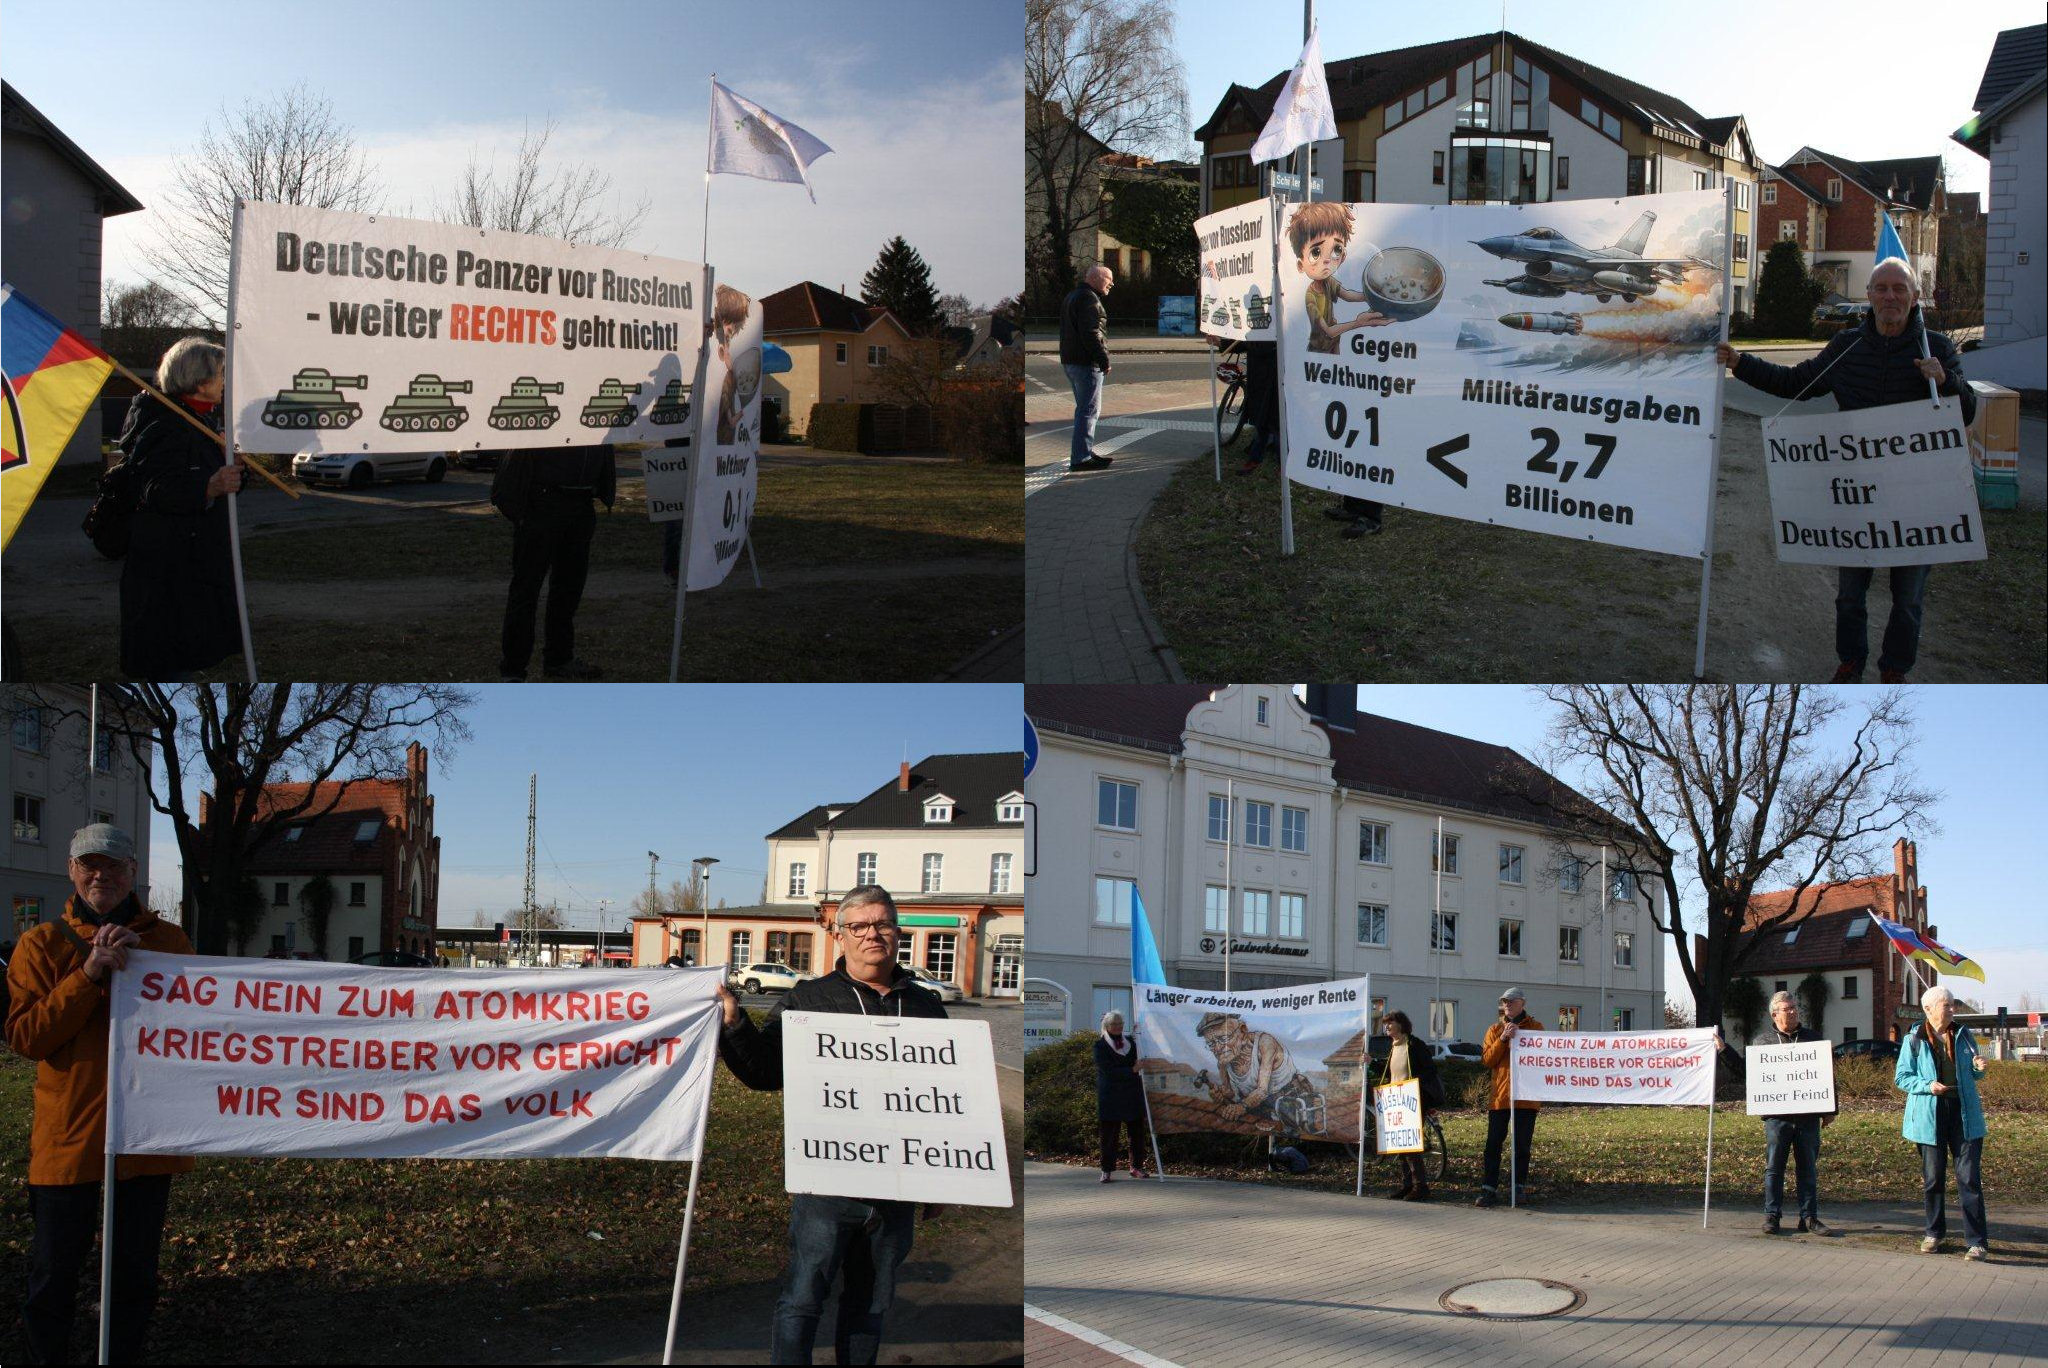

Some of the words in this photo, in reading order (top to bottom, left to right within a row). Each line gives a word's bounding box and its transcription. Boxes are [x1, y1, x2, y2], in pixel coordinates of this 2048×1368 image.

[1220, 215, 1263, 247] Russland
[276, 231, 448, 285] Deutsche
[455, 249, 553, 294] Panzer
[558, 267, 597, 299] vor
[602, 268, 693, 310] Russland
[1229, 251, 1254, 277] nicht!
[329, 298, 443, 340] weiter
[449, 303, 557, 346] RECHTS
[562, 315, 616, 351] geht
[619, 318, 679, 351] nicht!
[1350, 333, 1418, 363] Gegen
[1303, 361, 1416, 398] Welthunger
[1461, 377, 1701, 426] Militärausgaben
[1324, 400, 1380, 448] 0,1
[1526, 426, 1617, 484] 2,7
[1768, 427, 1964, 463] Nord-Stream
[1306, 447, 1395, 485] Billionen
[1505, 484, 1634, 526] Billionen
[1830, 477, 1877, 505] für
[1779, 514, 1974, 549] Deutschland
[139, 971, 218, 1006] SAG
[234, 980, 322, 1014] NEIN
[337, 985, 414, 1018] ZUM
[433, 990, 650, 1022] ATOMKRIEG
[1146, 989, 1192, 1006] Länger
[1193, 996, 1257, 1011] arbeiten,
[1262, 993, 1315, 1010] weniger
[1318, 988, 1357, 1004] Rente
[137, 1026, 439, 1072] KRIEGSTREIBER
[449, 1041, 521, 1072] VOR
[533, 1037, 682, 1071] GERICHT
[815, 1032, 958, 1065] Russland
[1519, 1037, 1543, 1048] SAG
[1547, 1038, 1576, 1049] NEIN
[1580, 1038, 1606, 1050] ZUM
[1611, 1037, 1688, 1050] ATOMKRIEG
[1759, 1049, 1817, 1064] Russland
[1518, 1055, 1615, 1069] KRIEGSTREIBER
[1618, 1057, 1644, 1069] VOR
[1647, 1055, 1702, 1069] GERICHT
[1761, 1072, 1777, 1083] ist
[1786, 1069, 1818, 1081] nicht
[1544, 1074, 1567, 1086] WIR
[1570, 1075, 1600, 1087] SIND
[1604, 1075, 1633, 1088] DAS
[1638, 1076, 1673, 1088] VOLK
[1753, 1093, 1789, 1103] unser
[1793, 1088, 1829, 1100] Feind
[217, 1084, 282, 1118] WIR
[295, 1089, 385, 1122] SIND
[404, 1092, 483, 1124] DAS
[504, 1088, 594, 1118] VOLK
[822, 1082, 860, 1110] ist
[882, 1086, 965, 1115] nicht
[1376, 1094, 1418, 1116] RUSSLAND
[801, 1138, 890, 1164] unser
[901, 1137, 996, 1171] Feind
